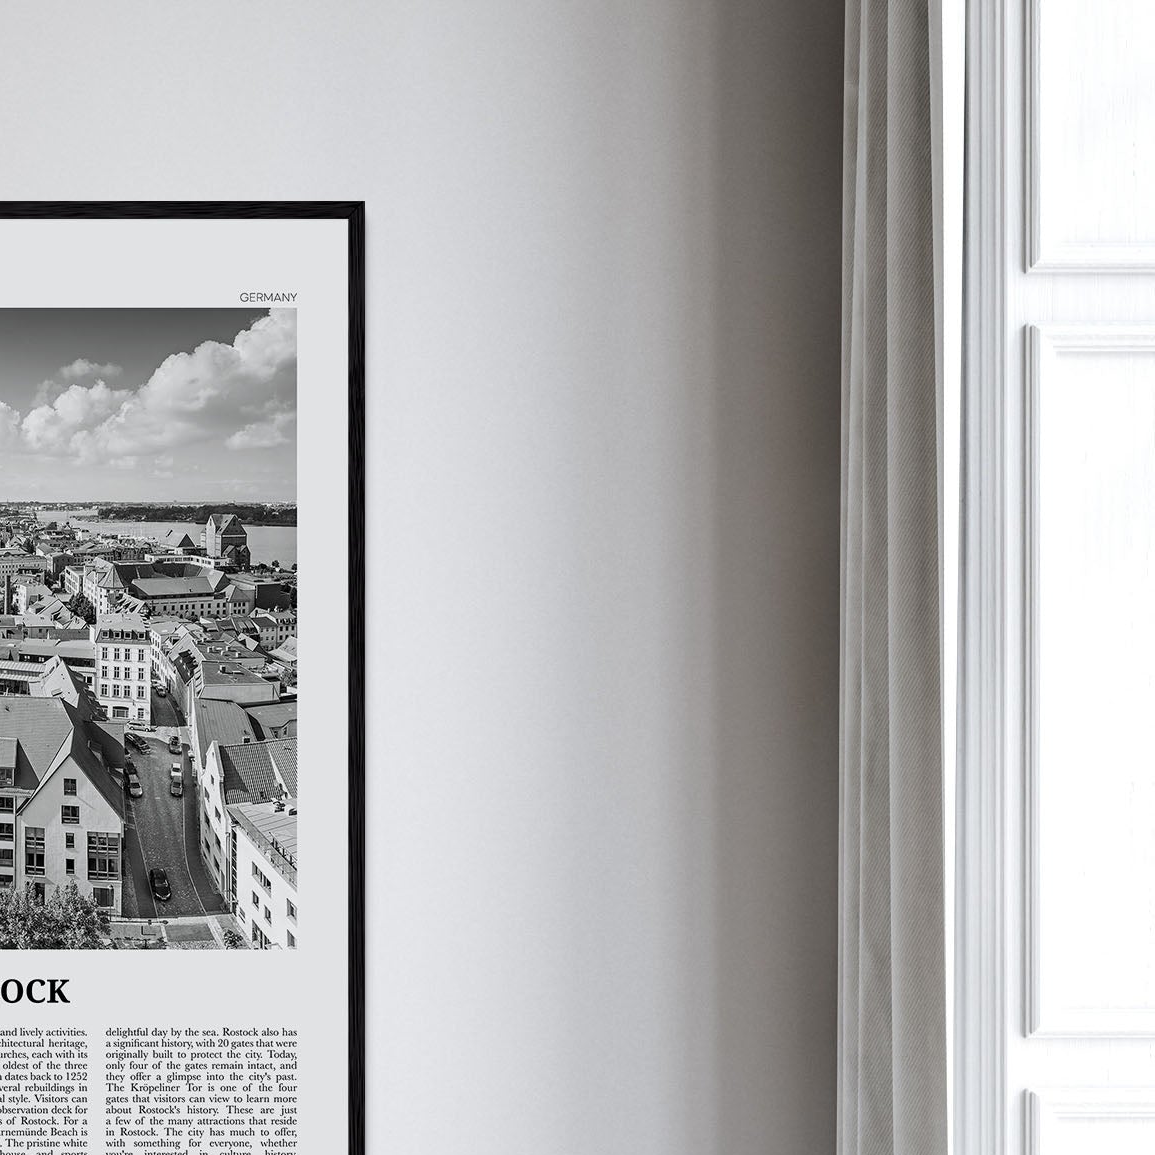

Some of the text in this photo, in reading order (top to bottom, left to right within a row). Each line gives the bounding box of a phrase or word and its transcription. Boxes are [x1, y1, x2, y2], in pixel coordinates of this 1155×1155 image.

[240, 293, 297, 302] GERMANY
[0, 1027, 18, 1037] and
[19, 1027, 44, 1039] lively
[45, 1027, 88, 1037] activities.
[105, 1027, 149, 1039] delightful
[151, 1027, 169, 1039] day
[170, 1027, 182, 1039] by
[184, 1027, 200, 1037] the
[222, 1027, 259, 1037] Rostock
[261, 1027, 280, 1037] also
[282, 1027, 298, 1037] has
[31, 1050, 53, 1059] each
[55, 1050, 75, 1059] with
[77, 1050, 88, 1059] its
[105, 1050, 298, 1061] originally built to protect the city. Today,
[4, 1072, 29, 1081] dates
[30, 1072, 52, 1081] back
[53, 1072, 63, 1081] to
[66, 1072, 88, 1081] 1252
[105, 1072, 126, 1083] they
[129, 1072, 152, 1081] offer
[166, 1072, 202, 1083] glimpse
[206, 1072, 225, 1081] into
[229, 1072, 244, 1081] the
[248, 1072, 272, 1083] city's
[275, 1072, 297, 1083] past.
[8, 1094, 31, 1105] style.
[34, 1094, 69, 1103] Visitors
[105, 1094, 129, 1105] gates
[132, 1094, 150, 1103] that
[153, 1094, 186, 1103] visitors
[208, 1094, 230, 1103] view
[233, 1094, 243, 1103] to
[246, 1094, 270, 1103] learn
[105, 1105, 132, 1114] about
[138, 1105, 181, 1114] Rostock's
[187, 1105, 219, 1117] history.
[225, 1105, 254, 1114] These
[281, 1105, 298, 1117] just
[5, 1116, 16, 1126] of
[20, 1116, 60, 1126] Rostock.
[63, 1116, 79, 1126] For
[4, 1138, 25, 1148] The
[26, 1138, 61, 1150] pristine
[62, 1138, 88, 1148] white
[105, 1138, 298, 1150] with something for everyone, whether
